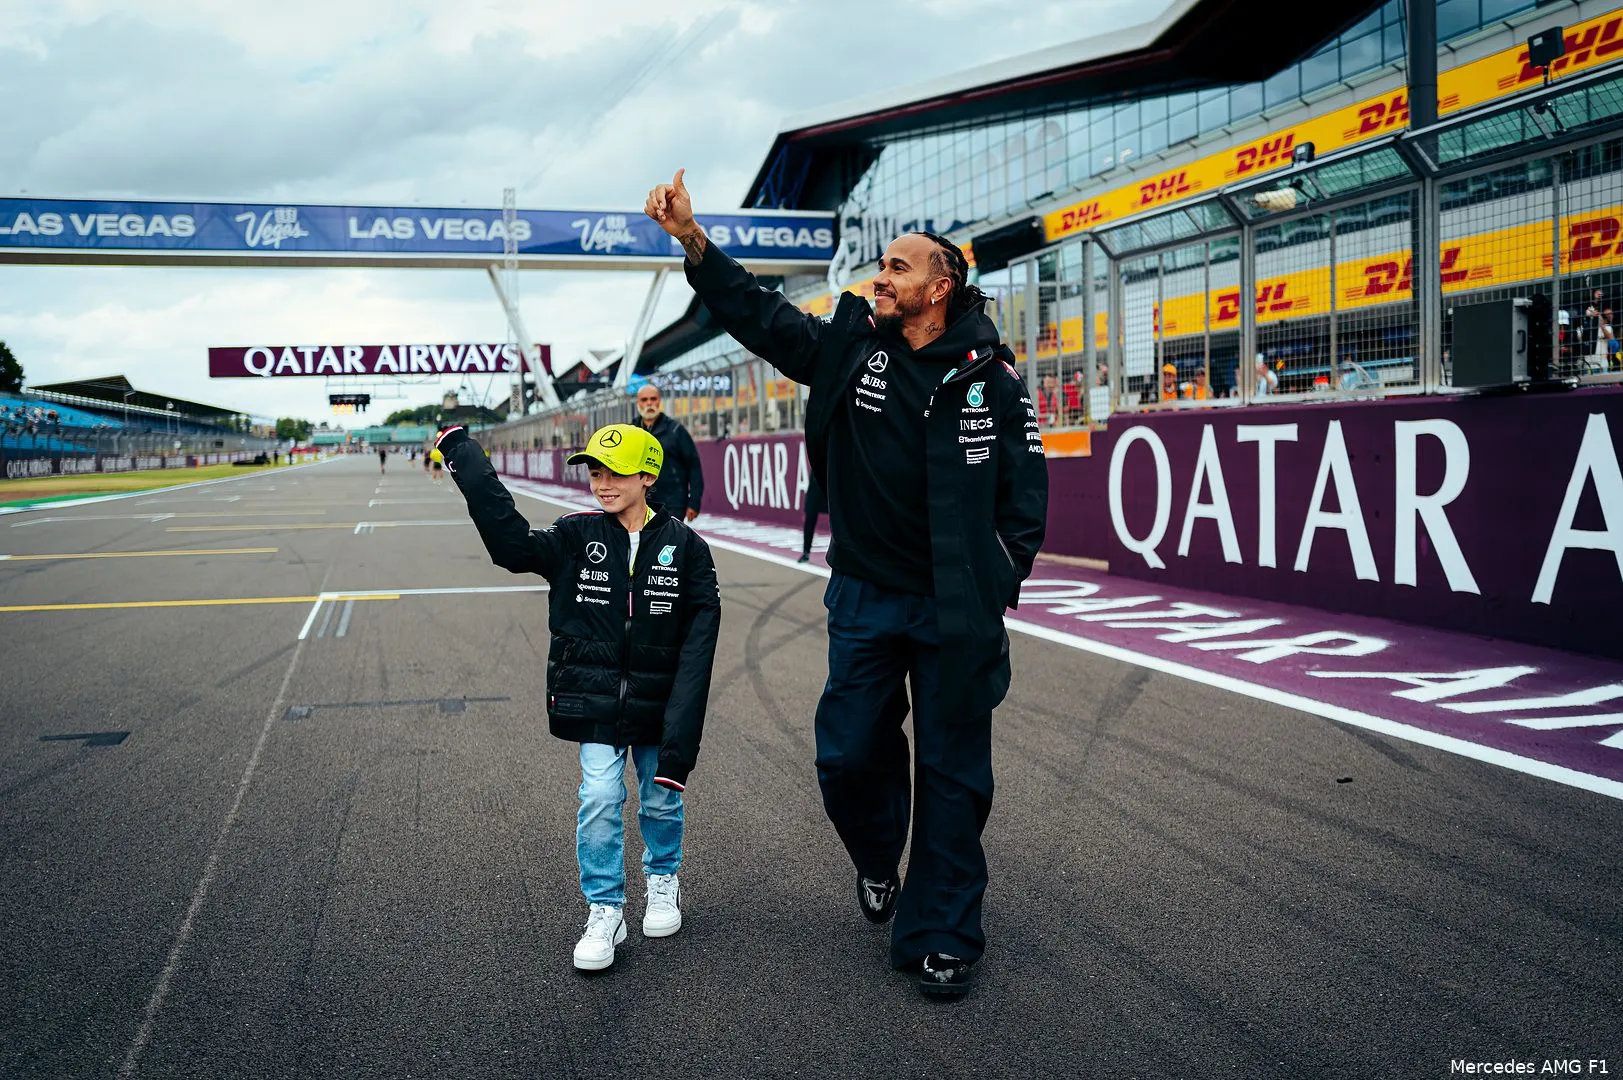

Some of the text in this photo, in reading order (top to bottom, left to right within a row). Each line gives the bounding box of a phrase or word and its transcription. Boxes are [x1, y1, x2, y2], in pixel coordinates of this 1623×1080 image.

[1140, 172, 1190, 204] DHL
[69, 213, 196, 237] VEGAS
[1062, 202, 1103, 230] DHL
[234, 208, 309, 249] Vegas
[349, 216, 532, 241] LAS VEGAS
[734, 225, 833, 248] VEGAS
[243, 344, 519, 377] QATAR AIRWAYS
[868, 375, 887, 390] UBS
[960, 418, 993, 431] INEOS
[964, 435, 997, 443] TeamViewer
[724, 442, 790, 511] QATAR
[1108, 418, 1482, 596] QATAR
[591, 571, 608, 581] UBS
[647, 575, 679, 586] INEOS
